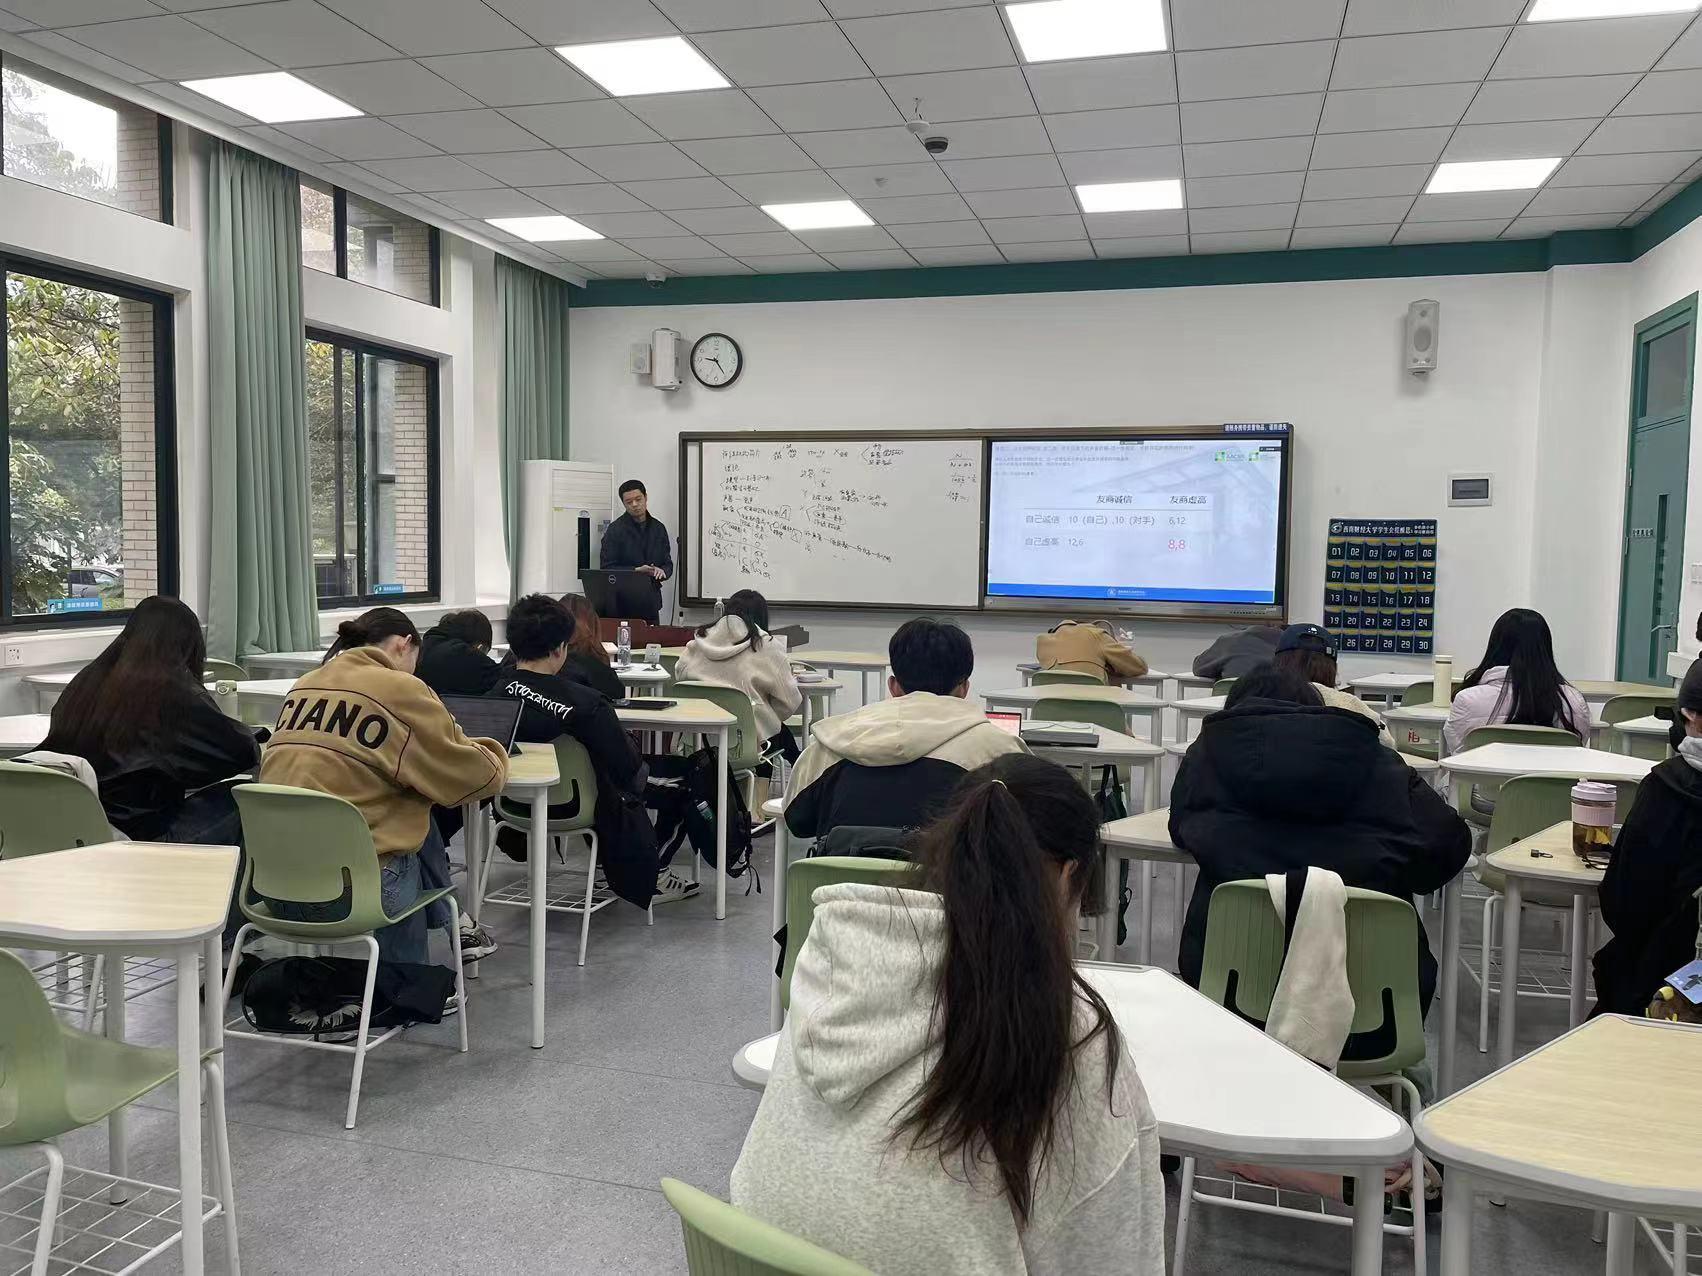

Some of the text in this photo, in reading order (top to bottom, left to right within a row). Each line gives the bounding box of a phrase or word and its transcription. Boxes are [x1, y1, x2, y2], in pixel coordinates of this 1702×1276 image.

[1096, 495, 1132, 504] 友商诚信
[1169, 495, 1207, 504] 友商虚高
[1169, 516, 1186, 526] 6,12
[1067, 538, 1084, 547] 12,6
[1168, 539, 1186, 551] 8,8
[1350, 548, 1359, 556] 02
[1369, 549, 1378, 557] 03
[1405, 549, 1414, 557] 05
[1423, 549, 1432, 557] 06
[1331, 571, 1340, 579] 07
[1350, 571, 1359, 579] 08
[1368, 571, 1377, 579] 09
[1331, 594, 1340, 602] 13
[1367, 596, 1376, 604] 15
[1403, 596, 1412, 604] 17
[1421, 596, 1430, 604] 18
[1383, 618, 1392, 626] 22
[1401, 618, 1410, 626] 23
[1347, 639, 1356, 647] 26
[1365, 639, 1374, 647] 27
[1383, 639, 1392, 648] 28
[1401, 640, 1410, 648] 29
[1419, 641, 1428, 649] 30
